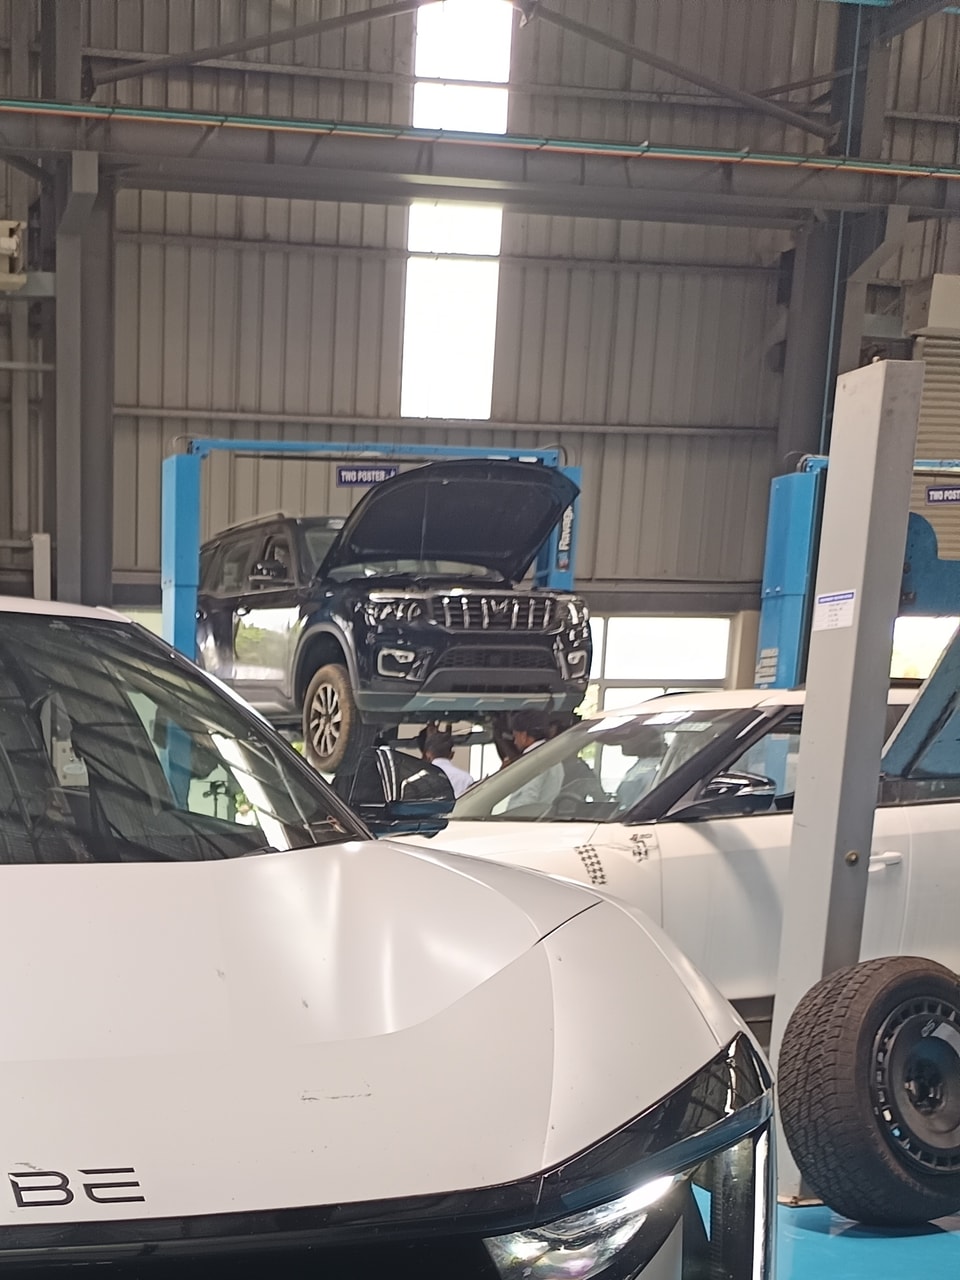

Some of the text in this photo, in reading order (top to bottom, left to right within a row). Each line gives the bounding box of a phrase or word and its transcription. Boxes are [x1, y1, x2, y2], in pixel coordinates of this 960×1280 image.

[341, 469, 356, 482] TWO
[357, 469, 385, 482] POSTER
[8, 1167, 145, 1207] BE
